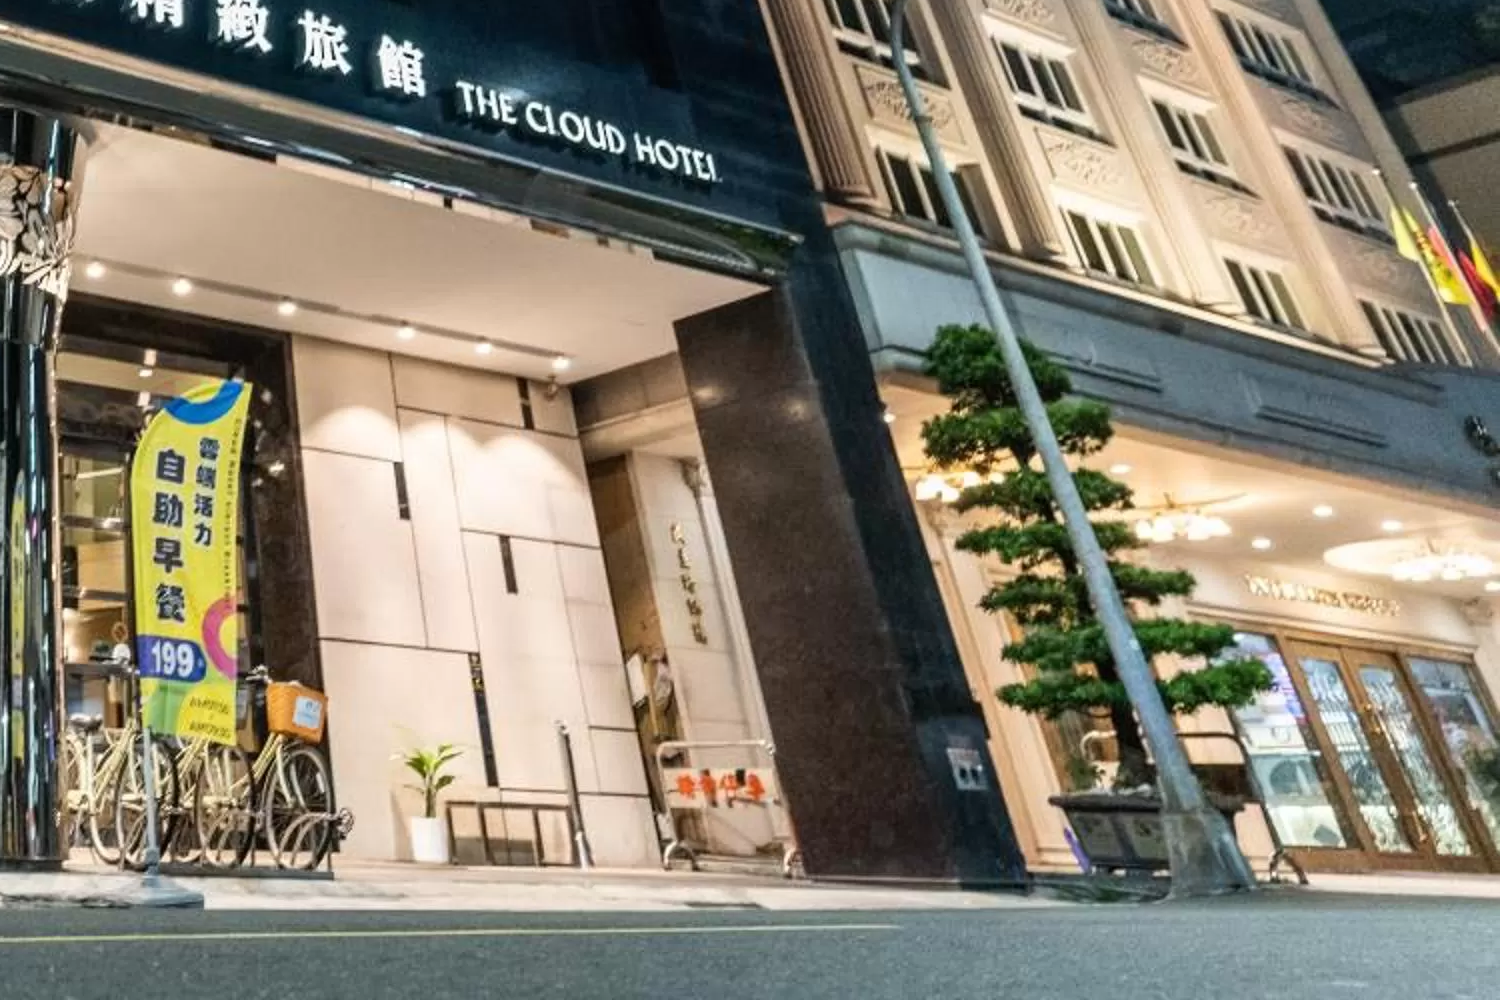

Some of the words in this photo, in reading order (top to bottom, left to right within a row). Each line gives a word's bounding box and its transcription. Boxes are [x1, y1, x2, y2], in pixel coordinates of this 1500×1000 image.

[455, 79, 517, 125] THE
[525, 101, 627, 154] CLOUD
[633, 132, 723, 183] HOTEL
[153, 448, 187, 623] 自助早餐
[194, 437, 220, 546] 雲端活力
[152, 640, 194, 678] 199
